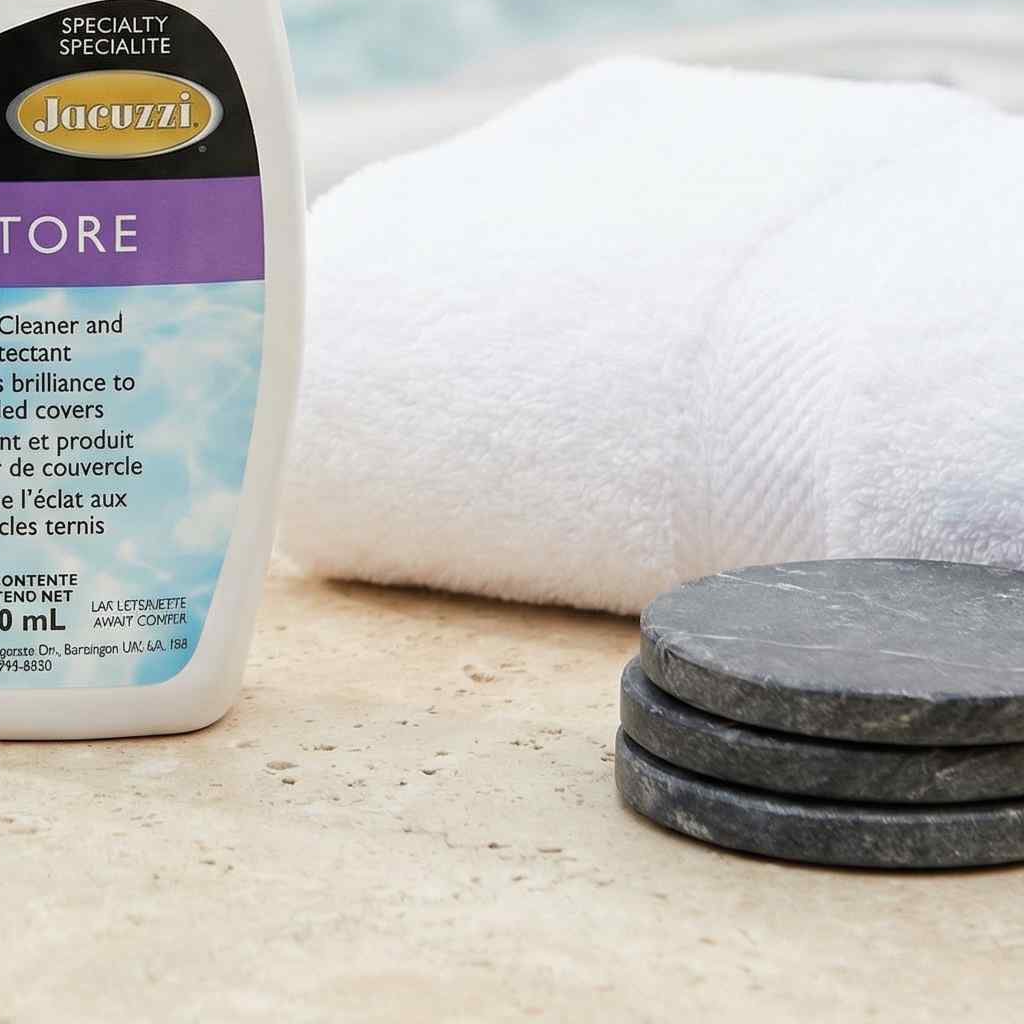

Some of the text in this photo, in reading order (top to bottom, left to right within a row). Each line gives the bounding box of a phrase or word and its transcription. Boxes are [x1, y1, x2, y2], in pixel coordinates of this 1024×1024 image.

[62, 16, 168, 34] SPECIALTY
[60, 38, 170, 55] SPECIALITE
[32, 90, 193, 134] Jacuzzi
[87, 312, 122, 334] and
[12, 372, 105, 392] brilliance
[113, 375, 135, 391] to
[36, 405, 103, 419] covers
[29, 434, 50, 450] et
[57, 429, 134, 458] produit
[10, 457, 34, 477] de
[43, 455, 142, 476] couvercle
[91, 493, 127, 508] aux
[45, 516, 104, 535] ternis
[42, 590, 73, 602] NET
[23, 608, 65, 631] mL
